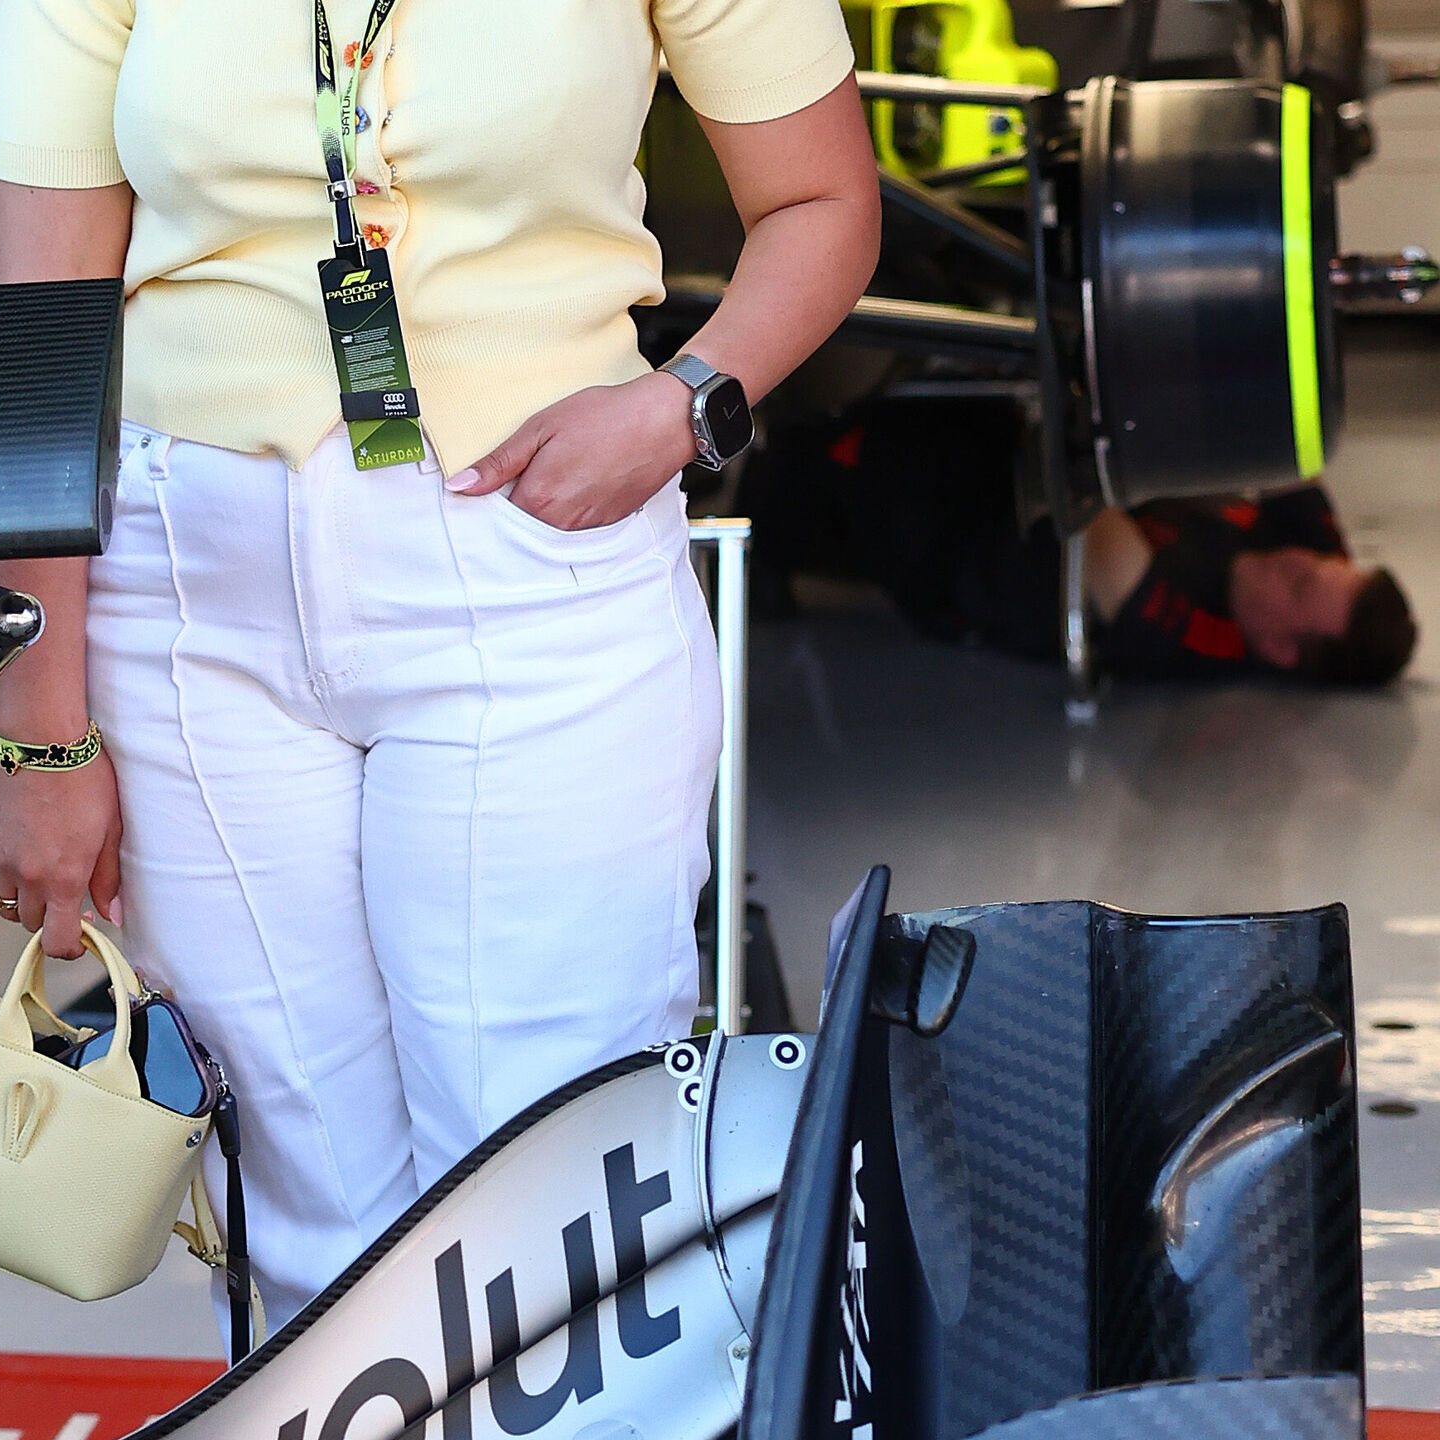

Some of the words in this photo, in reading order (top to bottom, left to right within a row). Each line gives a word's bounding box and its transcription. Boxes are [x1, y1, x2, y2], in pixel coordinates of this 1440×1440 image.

[325, 280, 389, 300] PADDOCK
[342, 291, 377, 305] CLUB
[357, 446, 421, 468] SATURDAY
